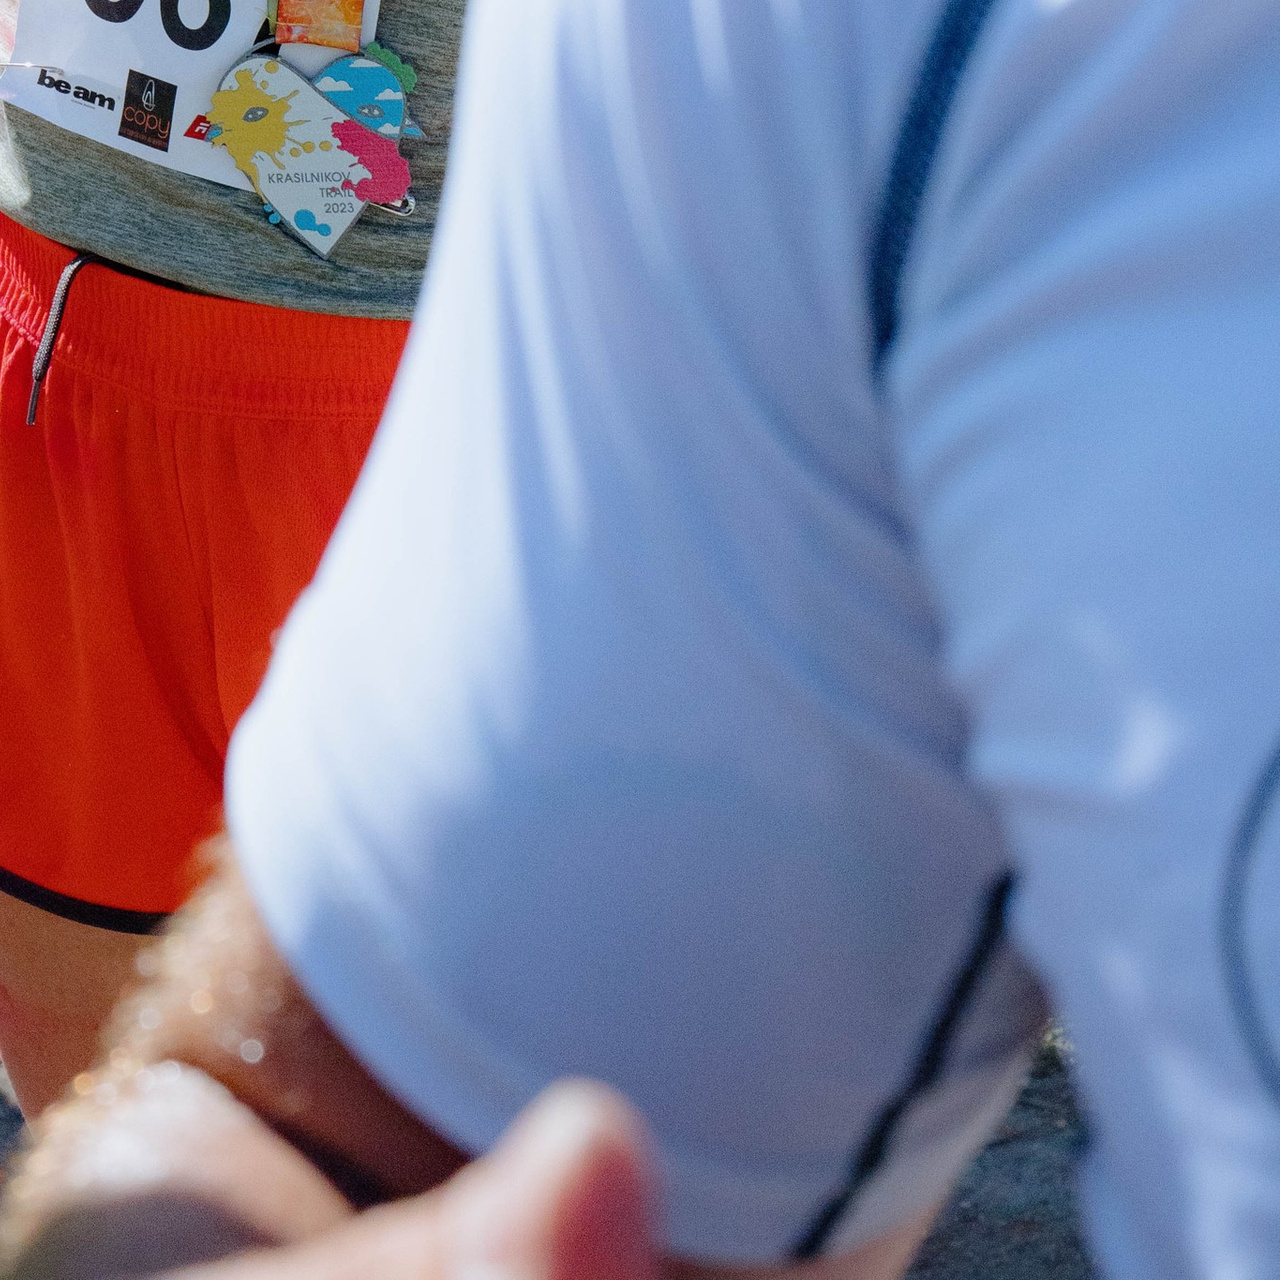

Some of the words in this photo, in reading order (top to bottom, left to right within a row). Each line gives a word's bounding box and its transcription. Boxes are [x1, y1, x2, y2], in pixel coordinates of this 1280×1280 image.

[123, 106, 171, 139] copy
[267, 171, 351, 184] KRASILNIKOV
[319, 187, 354, 198] TRAIL
[324, 202, 355, 214] 2023
